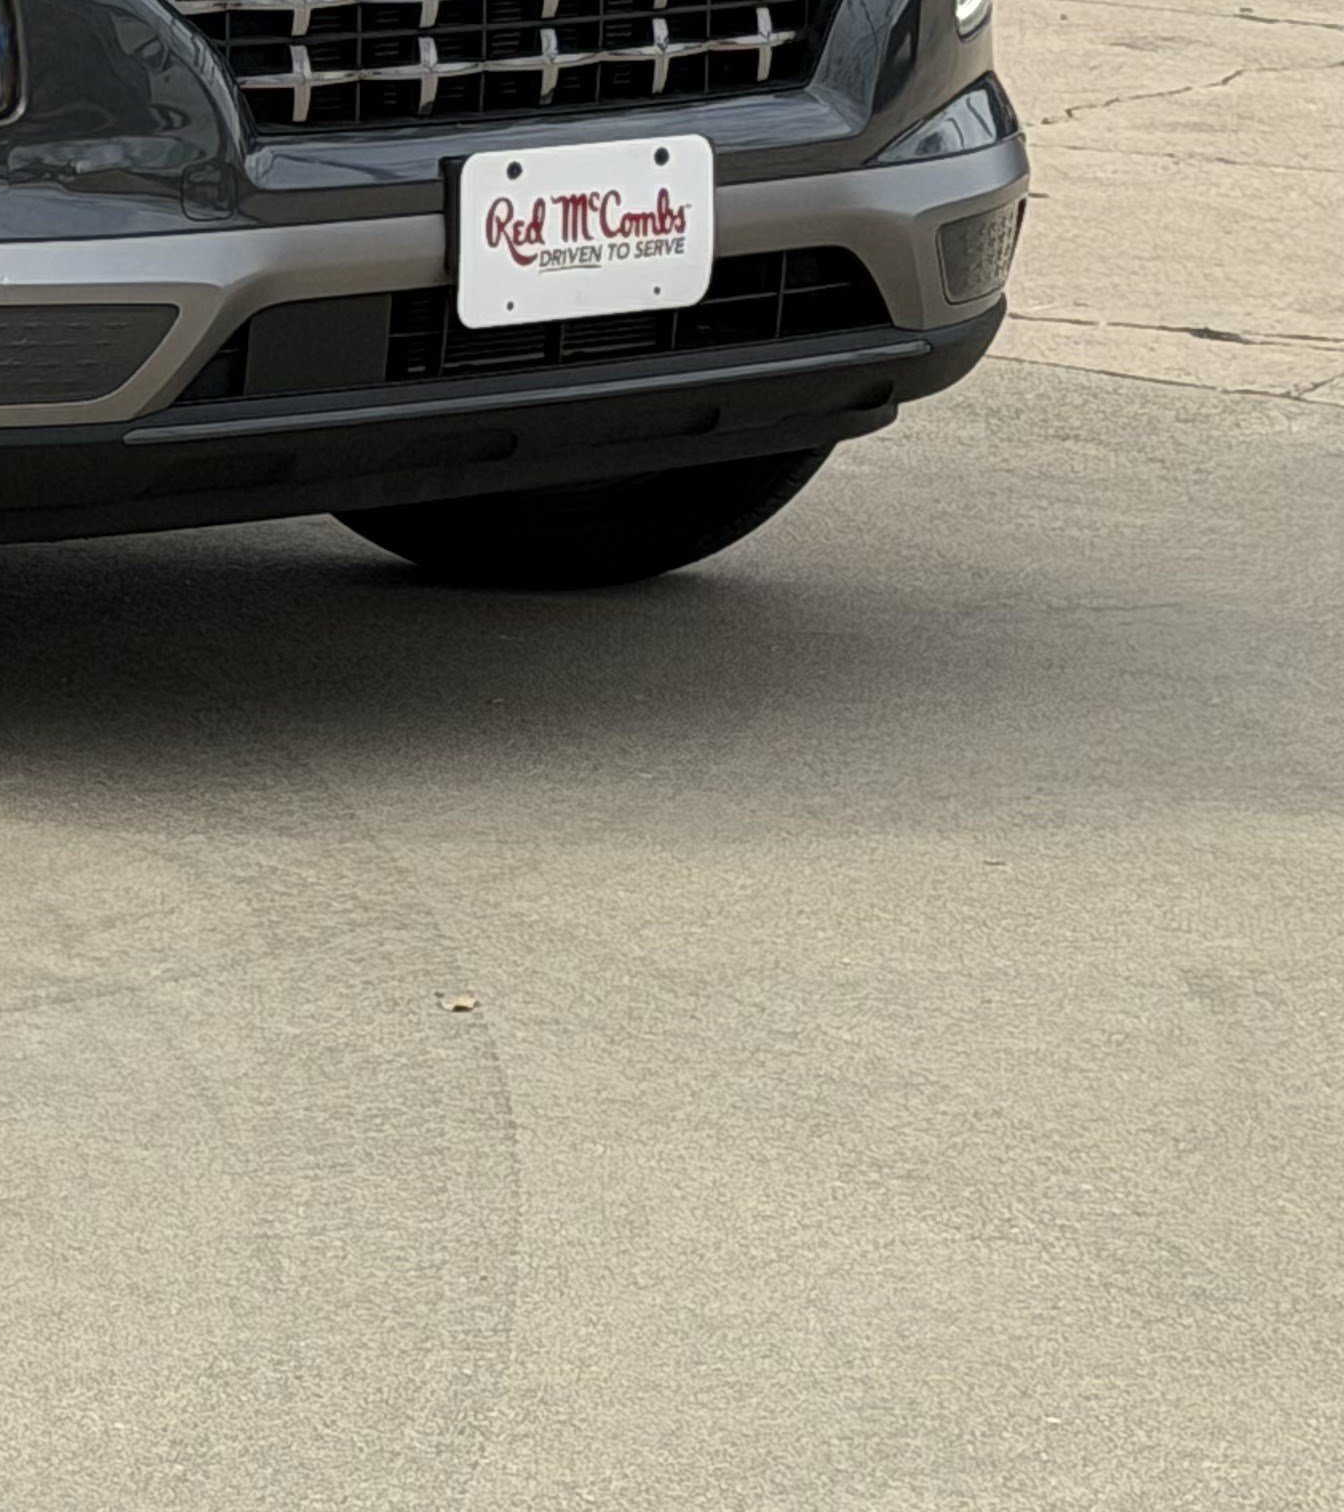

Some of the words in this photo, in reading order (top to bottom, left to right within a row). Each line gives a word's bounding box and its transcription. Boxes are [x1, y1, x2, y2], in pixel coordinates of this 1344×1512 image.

[486, 197, 546, 266] Red
[551, 188, 688, 244] McCombs
[539, 246, 603, 267] DRIVEN
[607, 242, 631, 260] TO
[634, 237, 686, 259] SERVE
